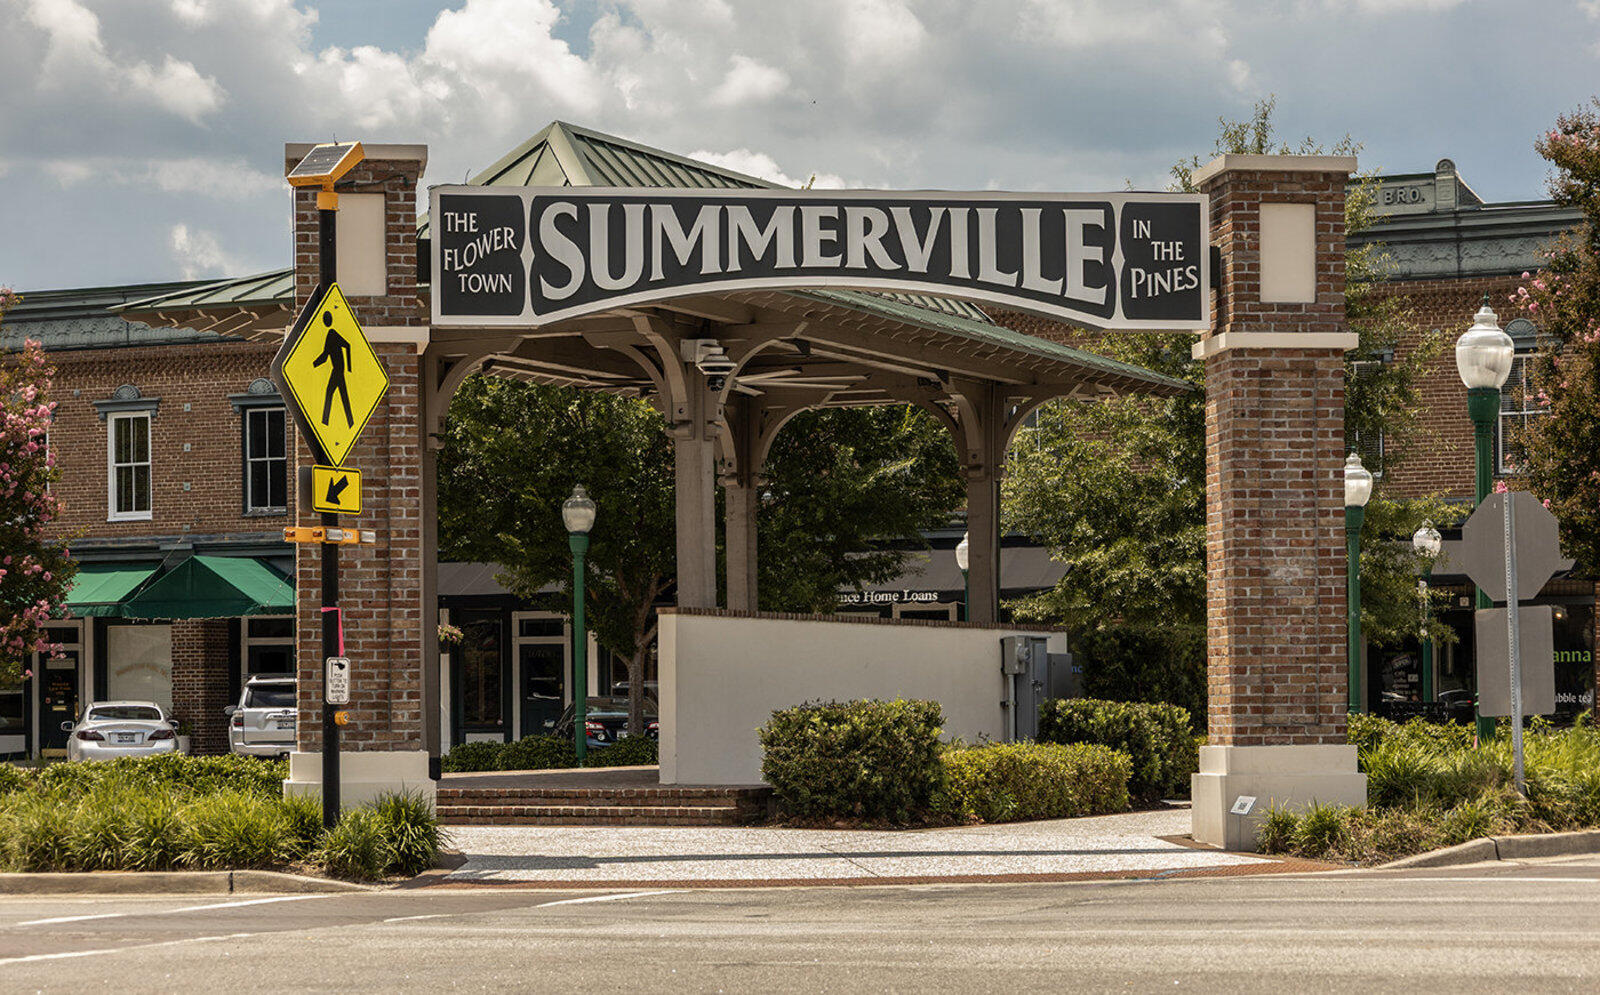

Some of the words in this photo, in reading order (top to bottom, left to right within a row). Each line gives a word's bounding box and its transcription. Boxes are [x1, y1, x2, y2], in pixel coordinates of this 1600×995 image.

[1384, 188, 1426, 205] BRO.
[444, 212, 479, 233] THE
[1132, 219, 1152, 239] IN
[443, 226, 517, 272] FLOWER
[538, 201, 1107, 305] SUMMERVILLE
[1151, 241, 1184, 261] THE
[458, 273, 513, 294] TOWN
[1130, 265, 1199, 299] PINES
[863, 590, 899, 602] Home
[903, 589, 938, 601] Loans
[1578, 694, 1592, 705] tea
